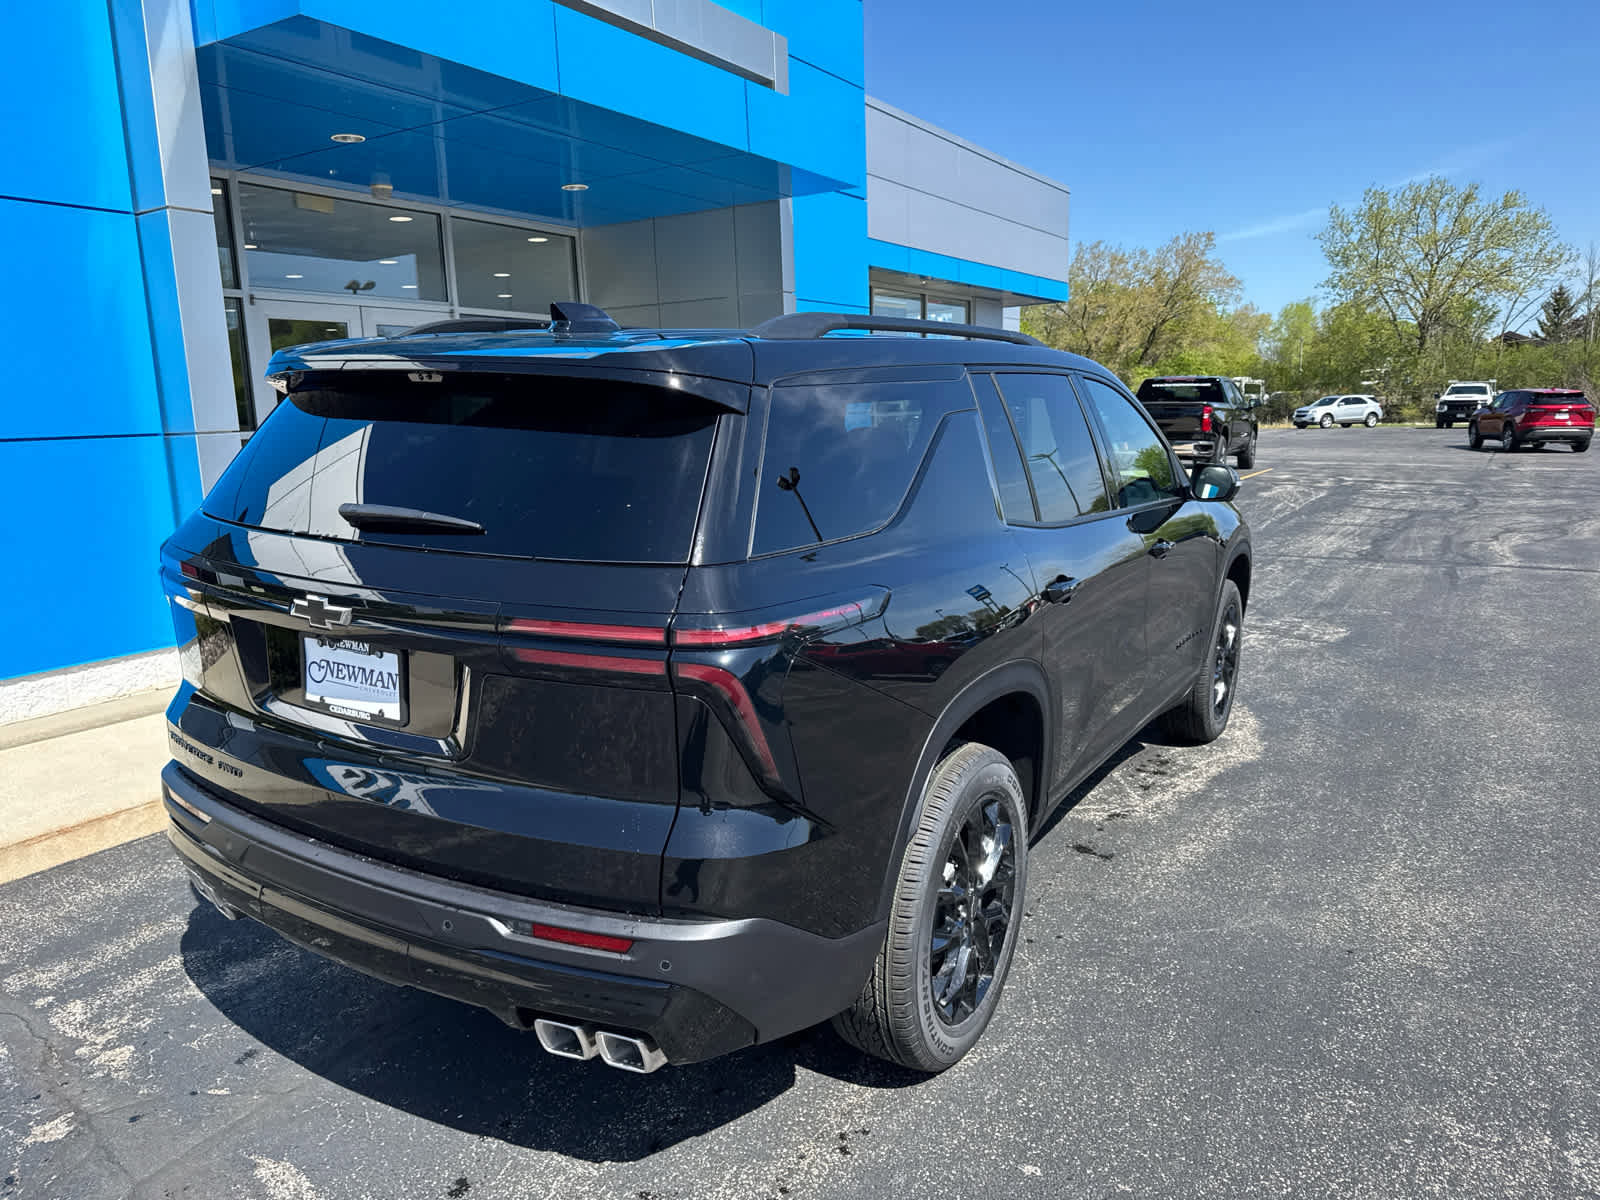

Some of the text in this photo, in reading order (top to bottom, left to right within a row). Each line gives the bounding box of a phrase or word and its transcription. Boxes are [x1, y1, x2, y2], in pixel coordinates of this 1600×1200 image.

[327, 639, 370, 652] NEWMAN
[308, 659, 400, 691] NEWMAN
[921, 945, 955, 1056] CONTINENTA
